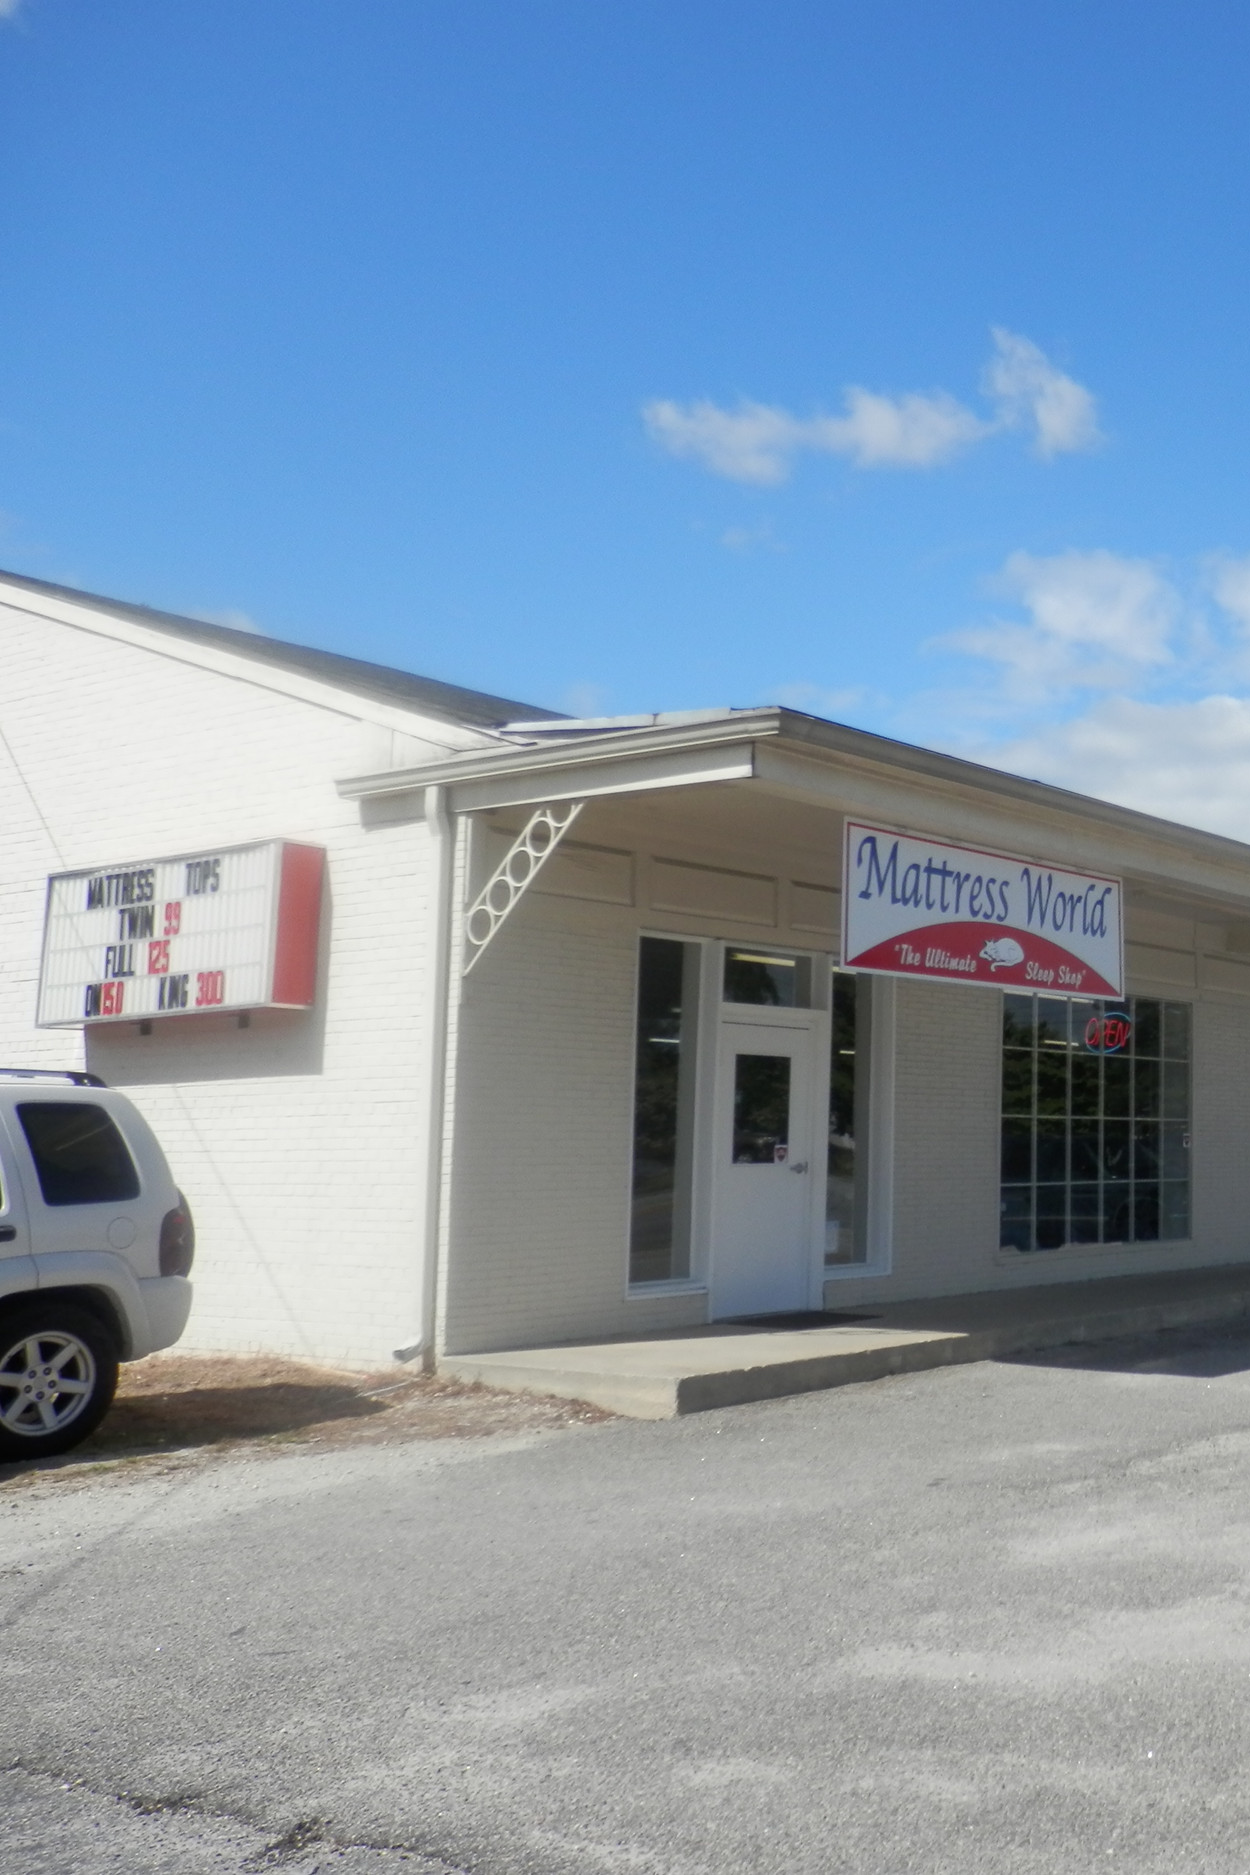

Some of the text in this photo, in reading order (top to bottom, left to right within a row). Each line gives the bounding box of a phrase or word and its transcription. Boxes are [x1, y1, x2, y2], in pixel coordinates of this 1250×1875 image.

[86, 858, 220, 911] MATTRESS TOPS
[857, 835, 1113, 938] Mattress World
[118, 902, 181, 941] TWIN 99
[105, 940, 170, 978] FULL 125
[925, 946, 977, 973] Ultimate
[1025, 961, 1055, 985] Sleep
[158, 974, 189, 1010] KING
[195, 970, 224, 1006] 300
